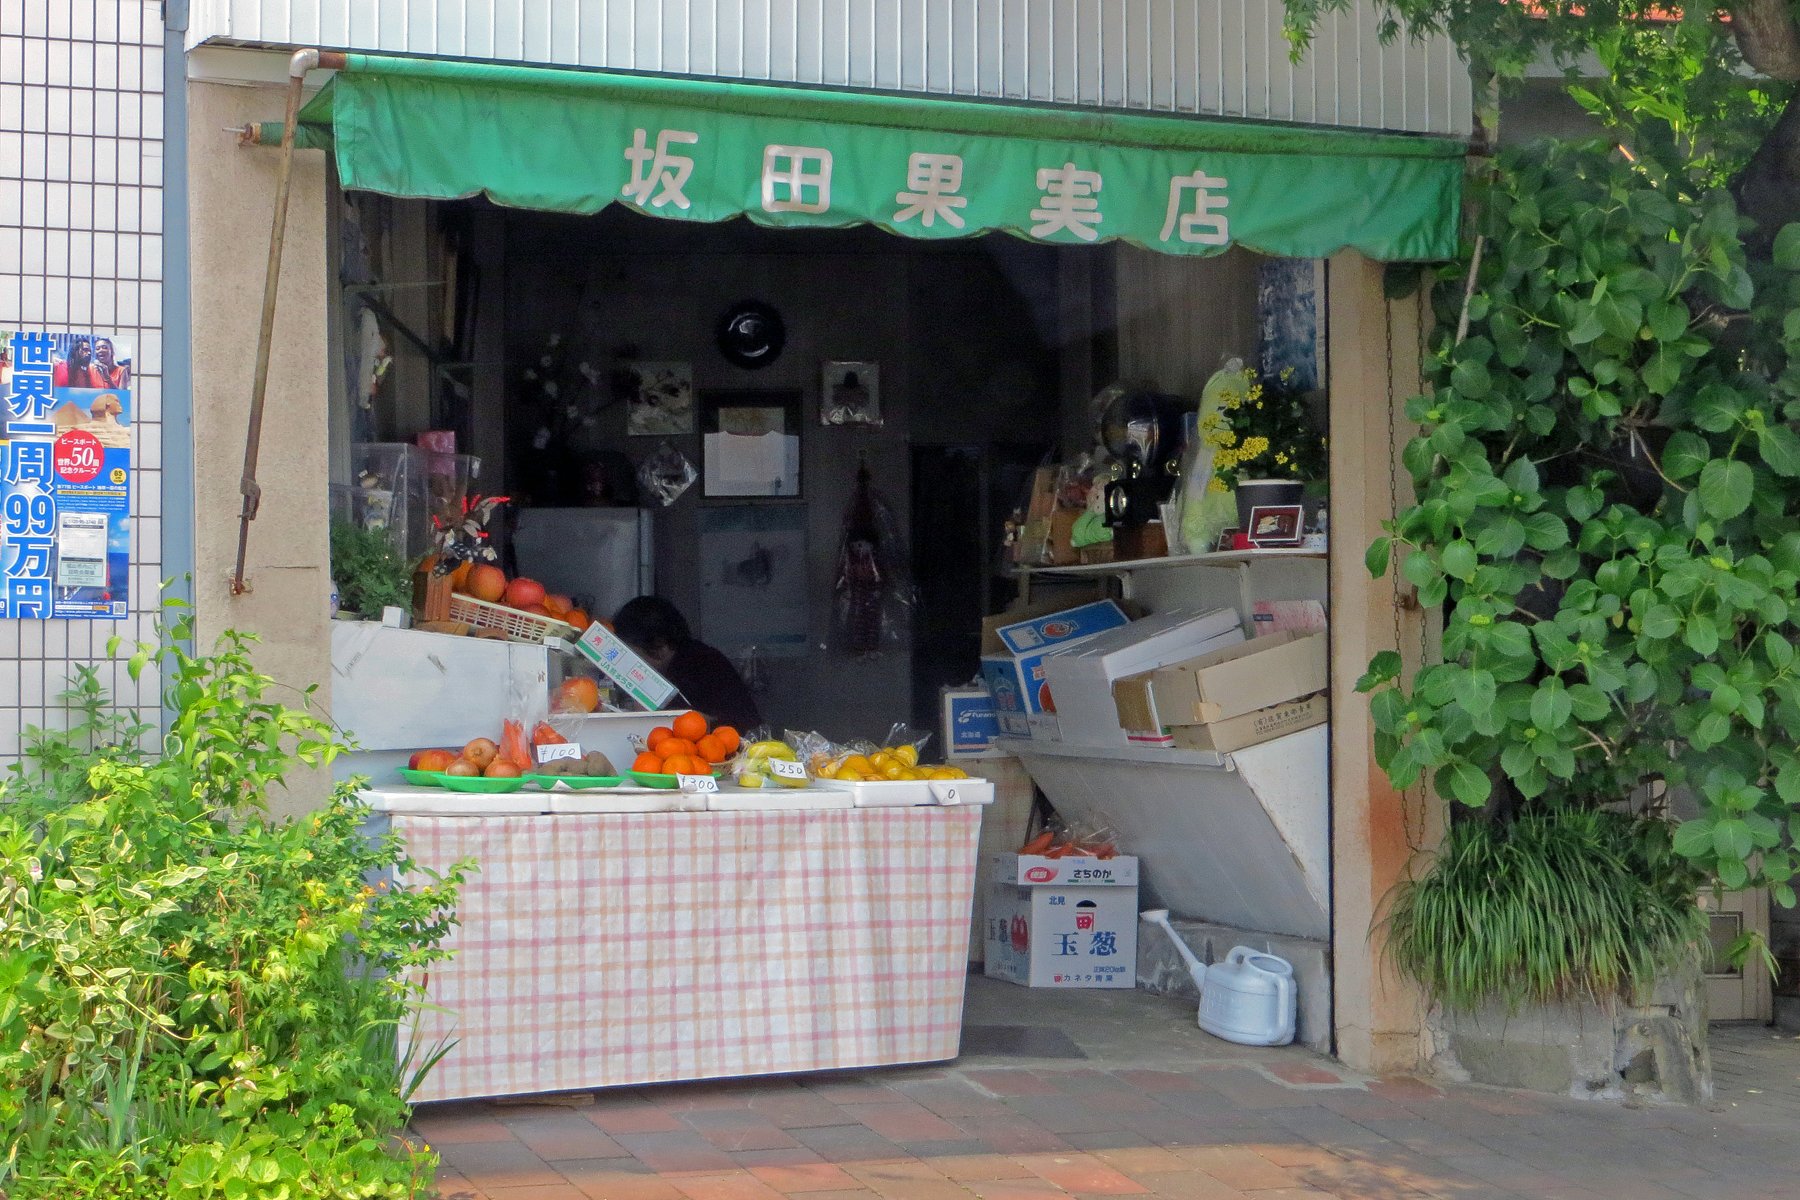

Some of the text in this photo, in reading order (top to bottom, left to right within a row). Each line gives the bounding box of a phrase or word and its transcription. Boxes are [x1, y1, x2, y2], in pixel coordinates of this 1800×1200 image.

[621, 127, 1230, 246] 坂田果実店
[1073, 868, 1112, 879] さちのか
[1048, 895, 1066, 906] 北見
[1051, 930, 1118, 957] 玉葱
